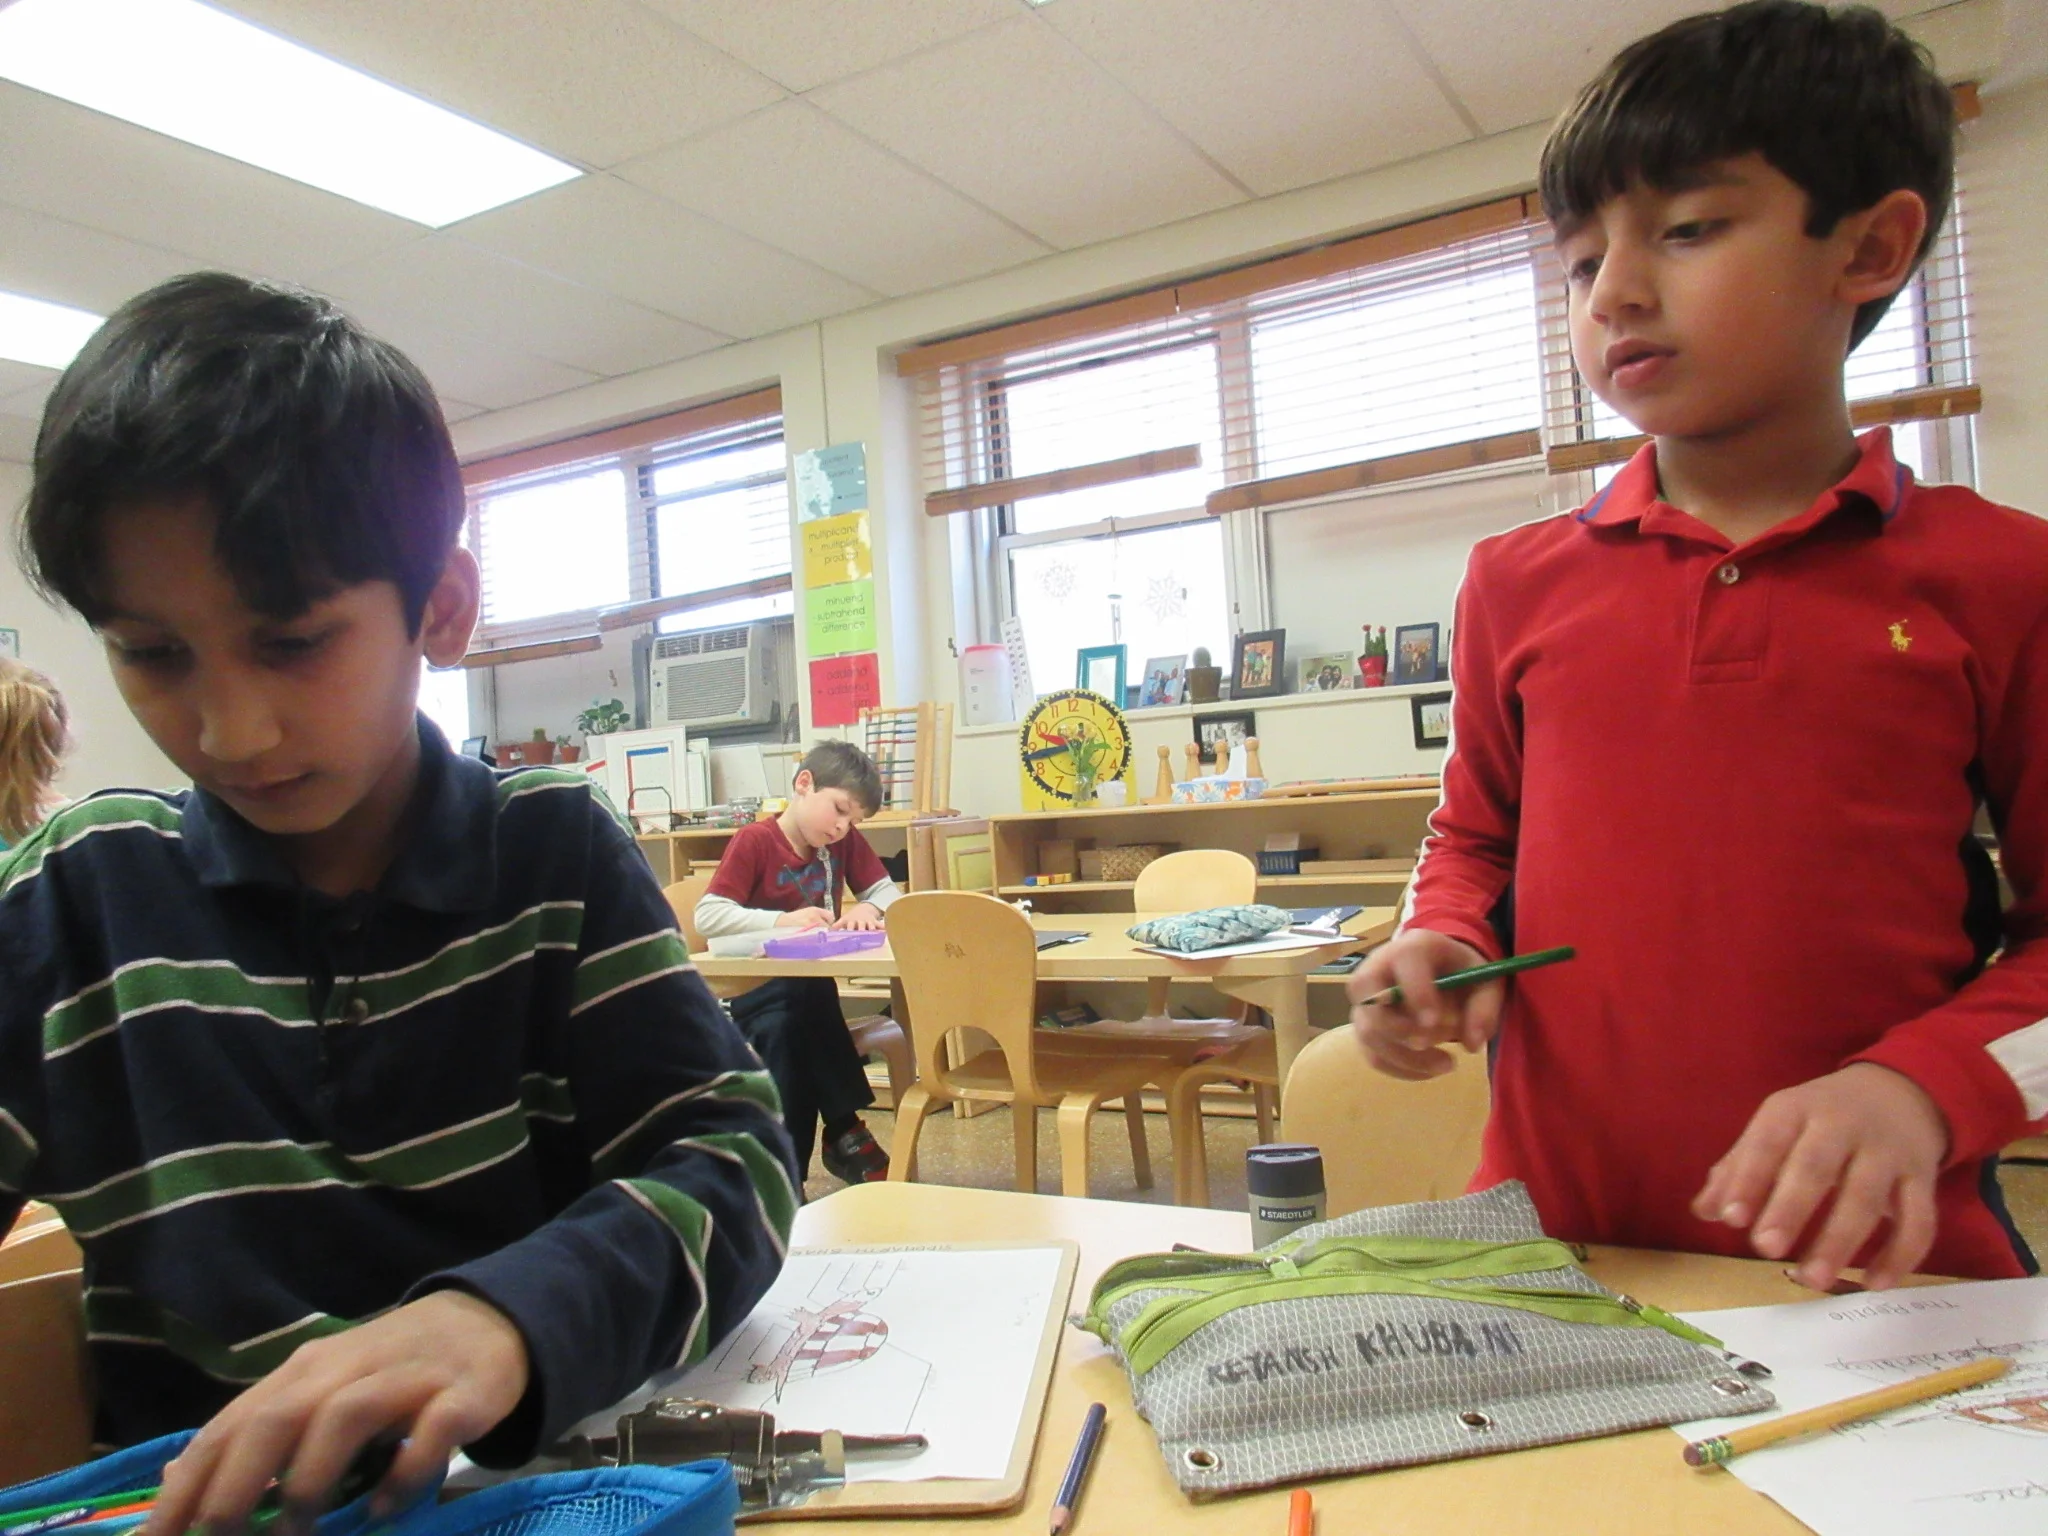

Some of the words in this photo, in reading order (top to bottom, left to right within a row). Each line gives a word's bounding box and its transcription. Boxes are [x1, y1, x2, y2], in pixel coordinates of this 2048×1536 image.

[825, 593, 864, 606] minuend
[821, 621, 866, 633] difference
[1050, 705, 1059, 718] 11
[1066, 698, 1079, 713] 12
[1091, 703, 1096, 716] 1
[1034, 720, 1048, 736] 10
[1106, 717, 1115, 731] 2
[1028, 741, 1037, 752] 9
[1114, 737, 1123, 751] 3
[1036, 762, 1045, 776] 8
[1109, 758, 1118, 771] 4
[1055, 775, 1065, 789] 7
[1097, 773, 1104, 782] 5
[1266, 1209, 1313, 1219] STAEDTLER
